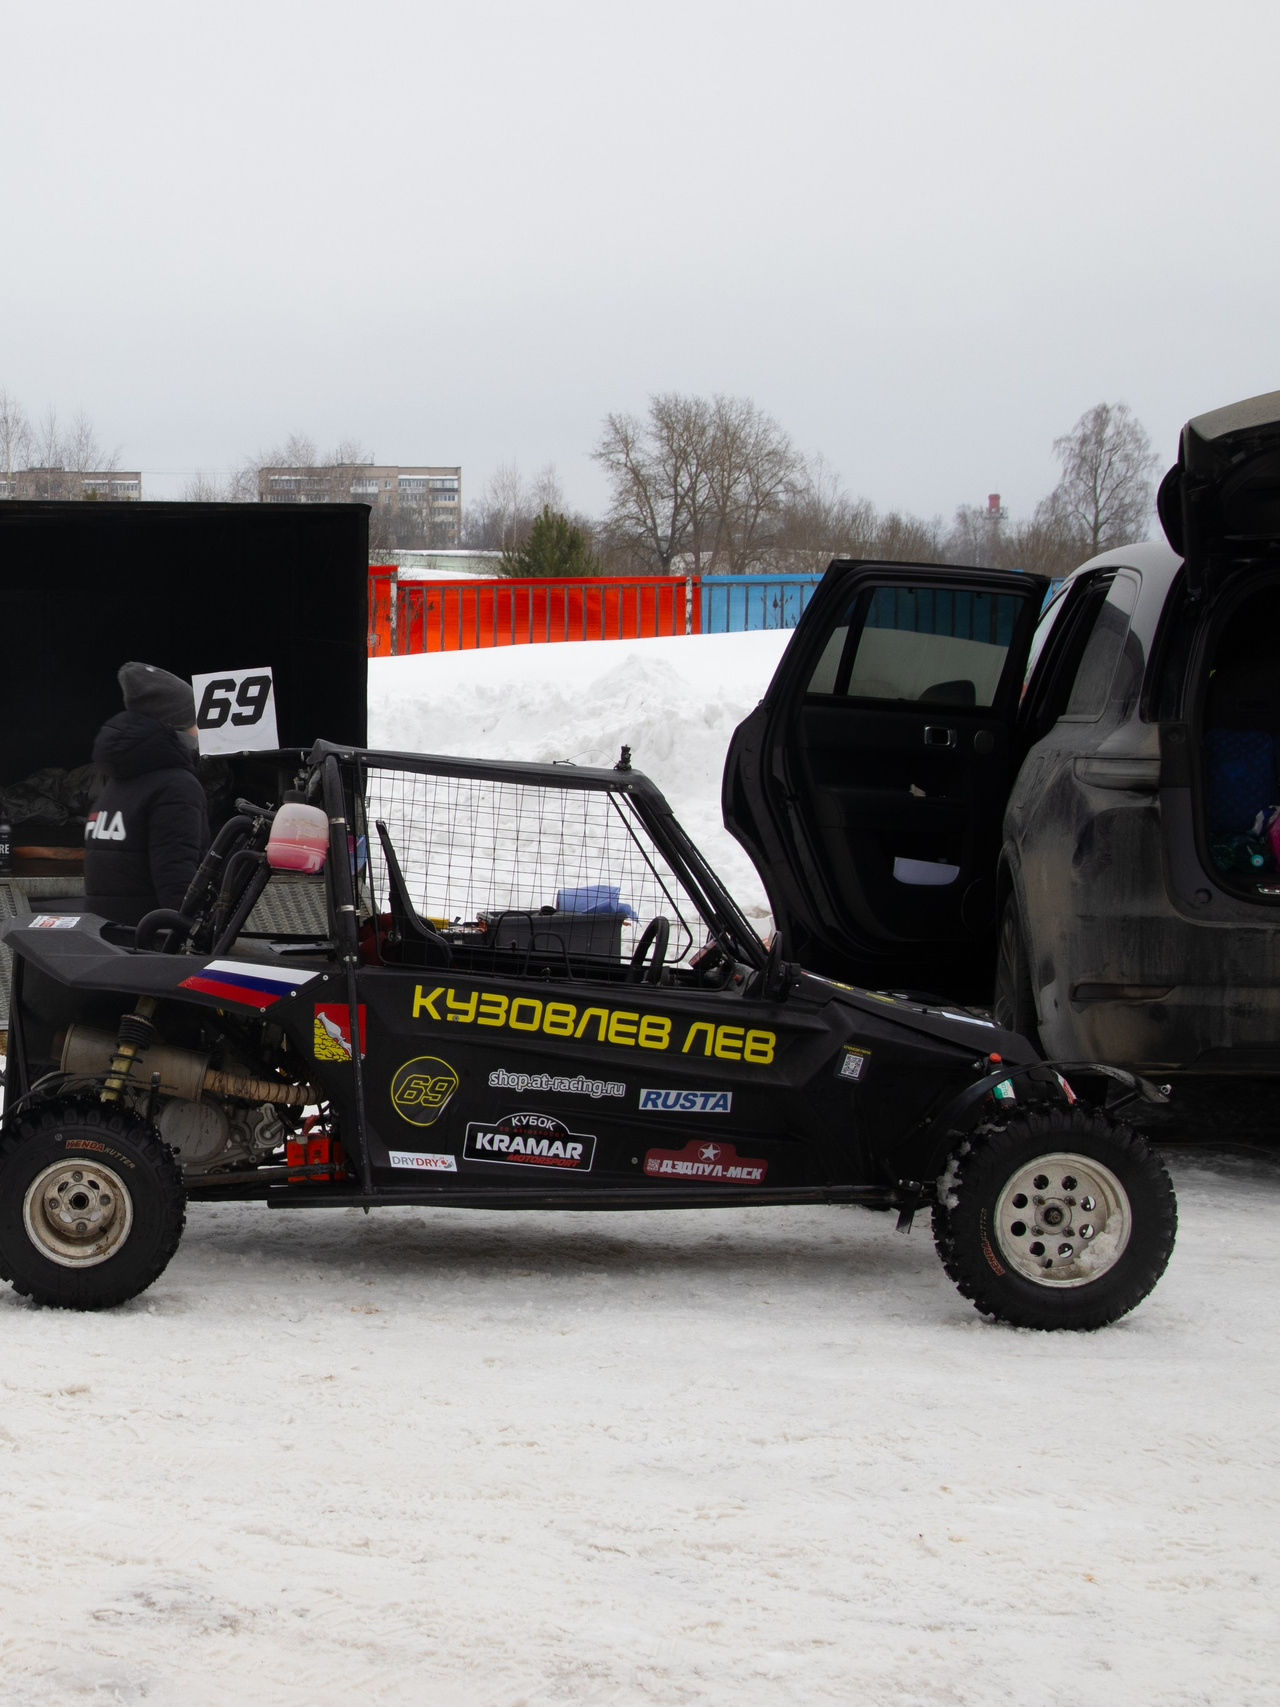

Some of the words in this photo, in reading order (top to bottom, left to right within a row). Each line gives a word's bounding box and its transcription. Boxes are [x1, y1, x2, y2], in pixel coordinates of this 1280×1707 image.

[196, 674, 272, 729] 69
[412, 984, 672, 1050] КУЗОВЛЕВ
[681, 1021, 777, 1064] ЛЕВ
[394, 1074, 456, 1107] 69
[489, 1069, 626, 1098] shop.at-racing.ru
[641, 1090, 729, 1111] RUSTA
[511, 1116, 557, 1131] КУБОК
[65, 1140, 105, 1153] KENDA
[104, 1147, 136, 1170] KUTTER
[475, 1132, 583, 1160] KRAMAR
[392, 1156, 439, 1168] DRYDRY
[507, 1154, 581, 1168] MOTORSPORT
[659, 1159, 763, 1180] ДЭДПУЛ-МСК
[979, 1240, 1007, 1277] KENDA
